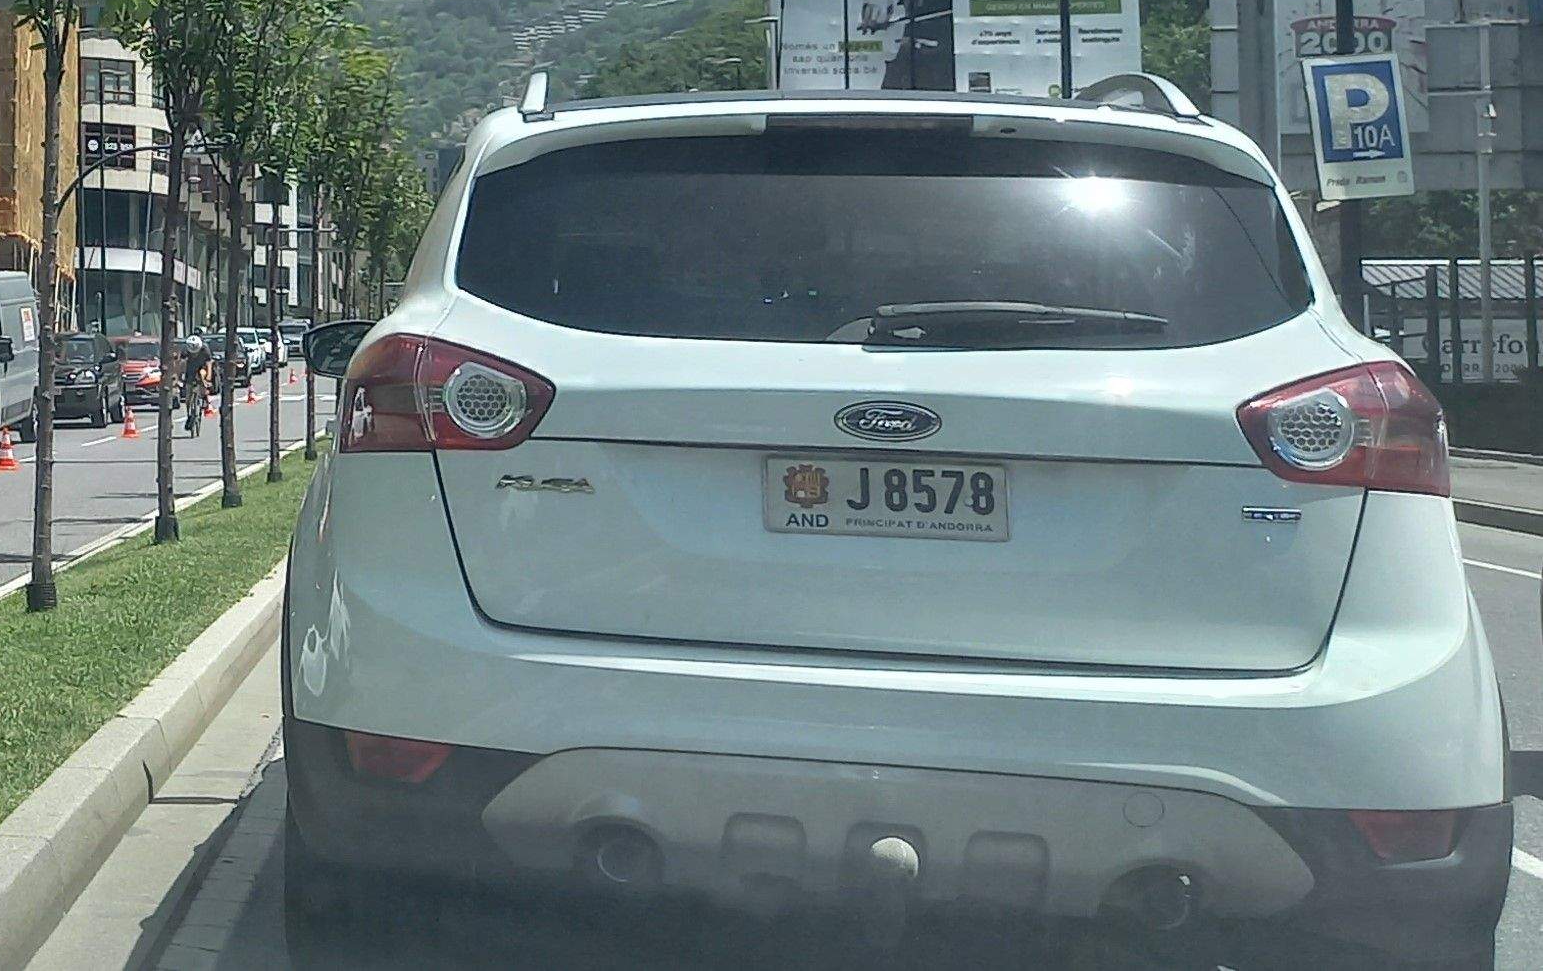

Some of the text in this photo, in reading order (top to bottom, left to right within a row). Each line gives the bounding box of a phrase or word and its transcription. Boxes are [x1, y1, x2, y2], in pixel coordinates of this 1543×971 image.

[1324, 73, 1390, 150] P
[1354, 124, 1396, 149] 10A
[859, 407, 916, 431] Ford
[846, 467, 996, 516] J 8578
[785, 513, 995, 533] AND PRINCIPAT D'ANDORRA
